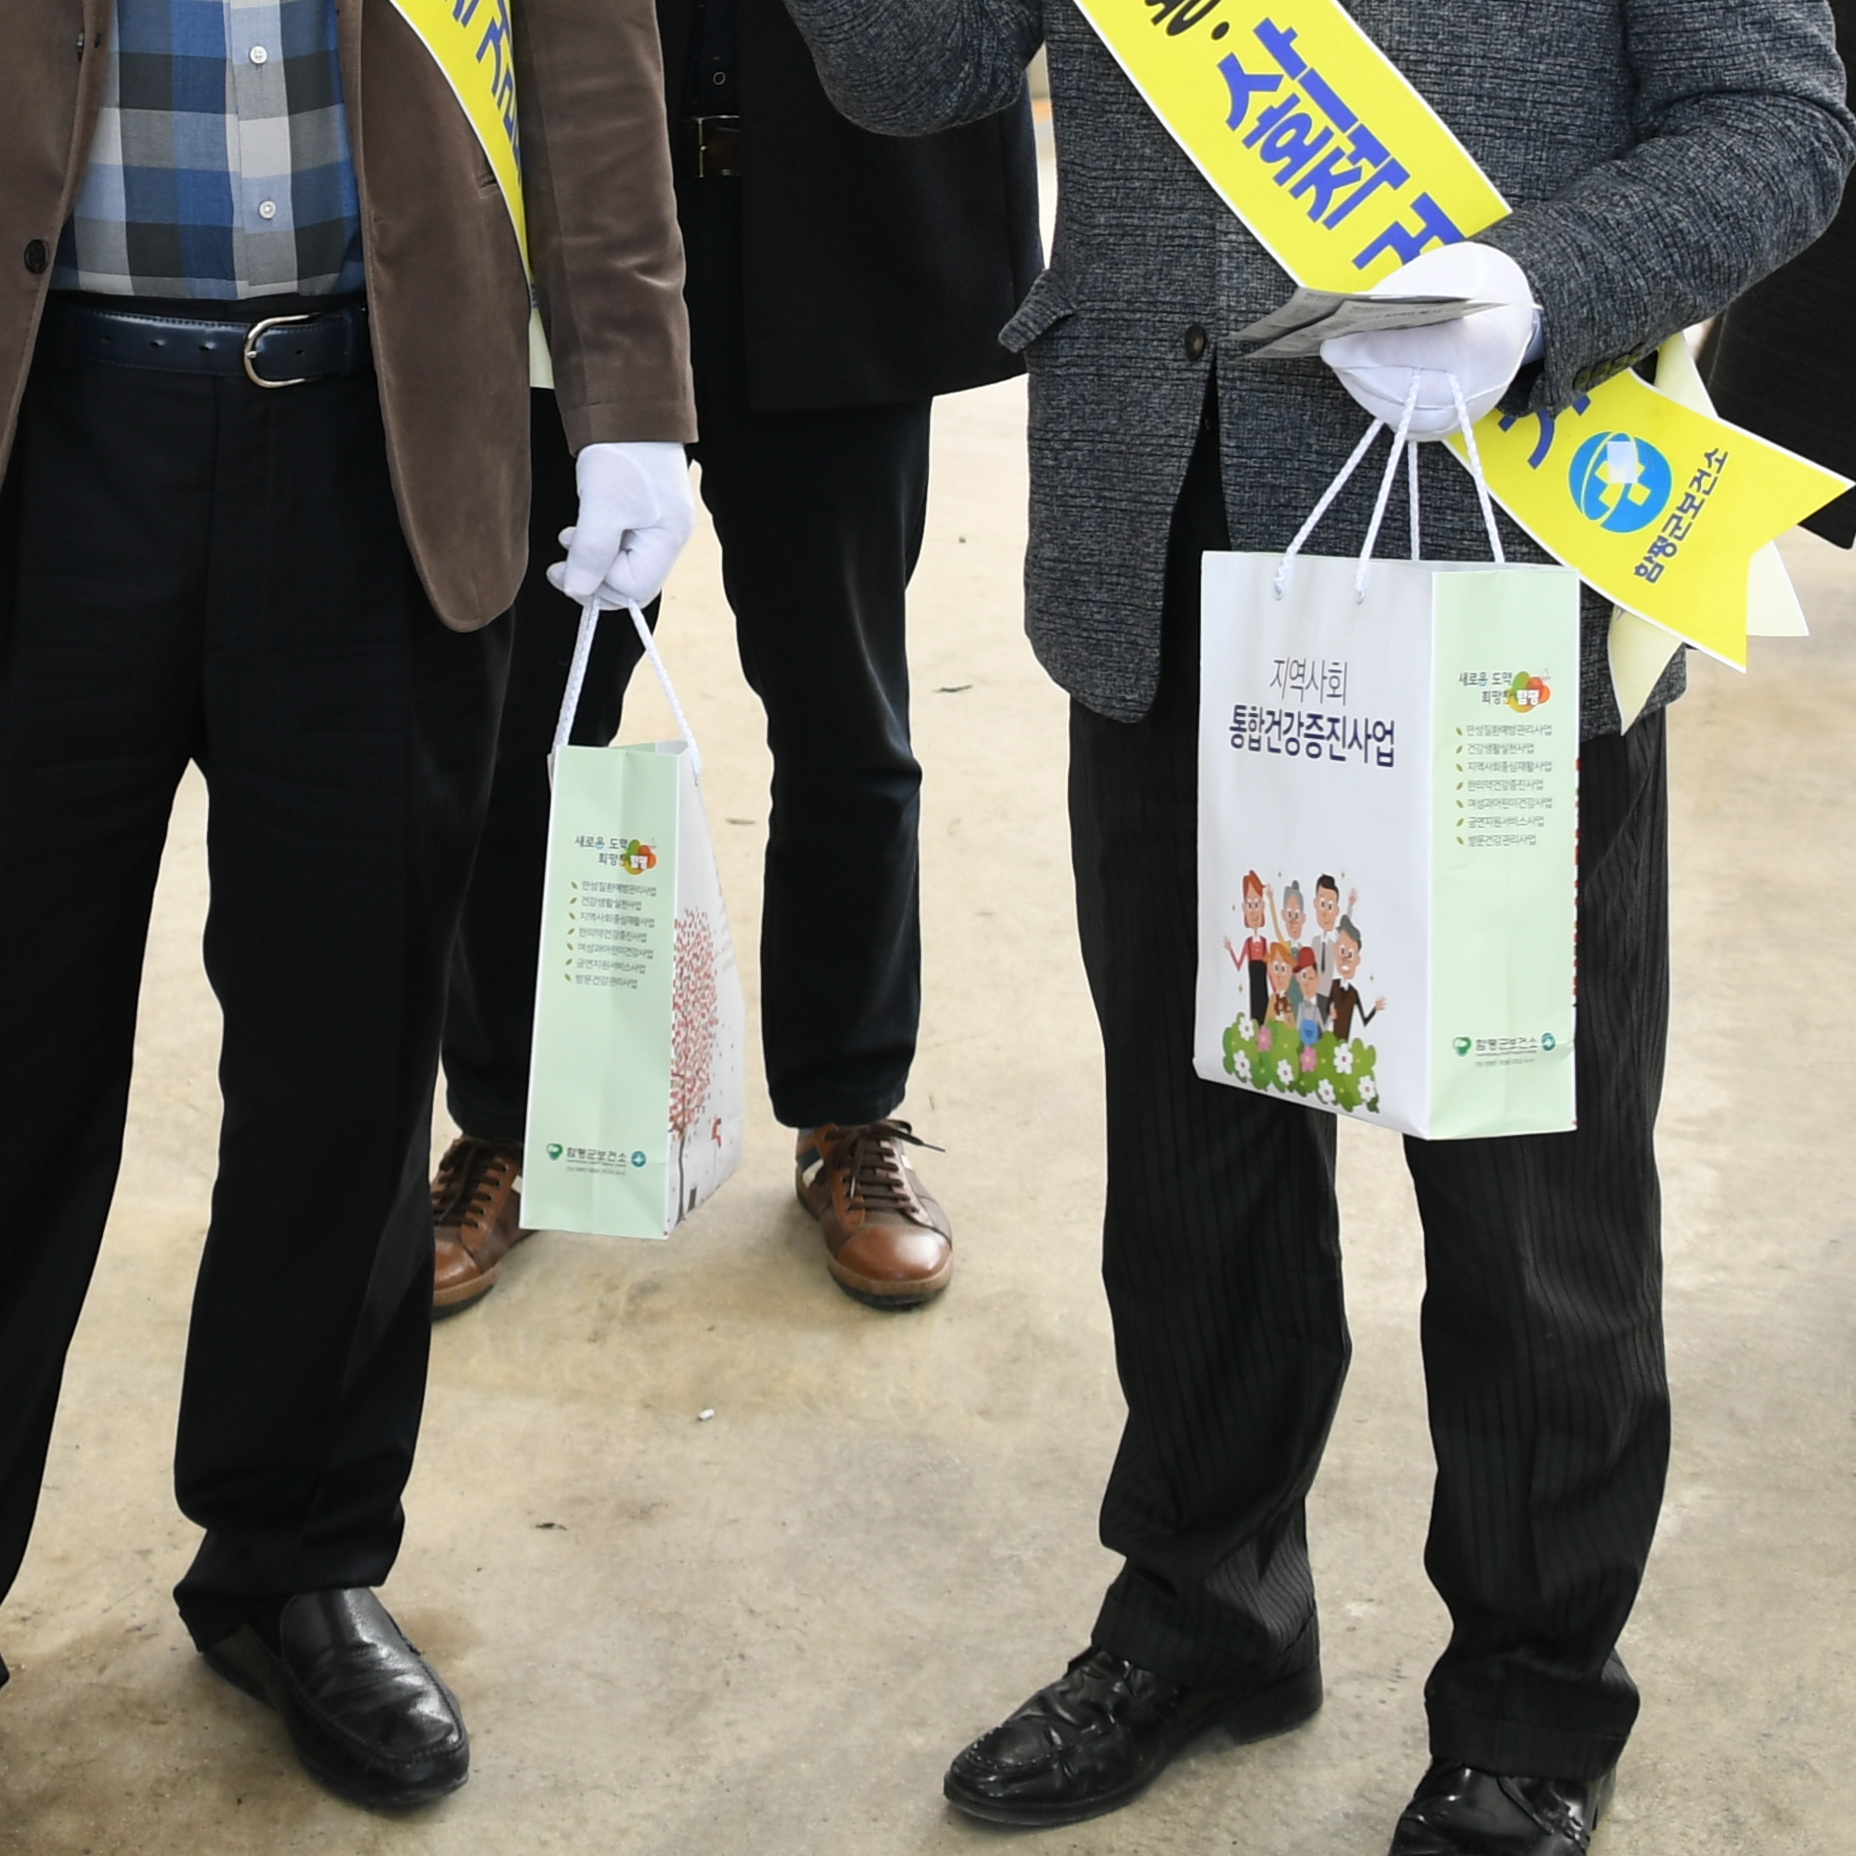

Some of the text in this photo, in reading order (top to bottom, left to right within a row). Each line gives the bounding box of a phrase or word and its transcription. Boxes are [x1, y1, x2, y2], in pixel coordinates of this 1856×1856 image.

[1217, 17, 1411, 232] 사회적
[1632, 443, 1729, 585] 함평군보건소
[1268, 655, 1350, 707] 지역사회
[1228, 703, 1396, 769] 통합건강증진사업
